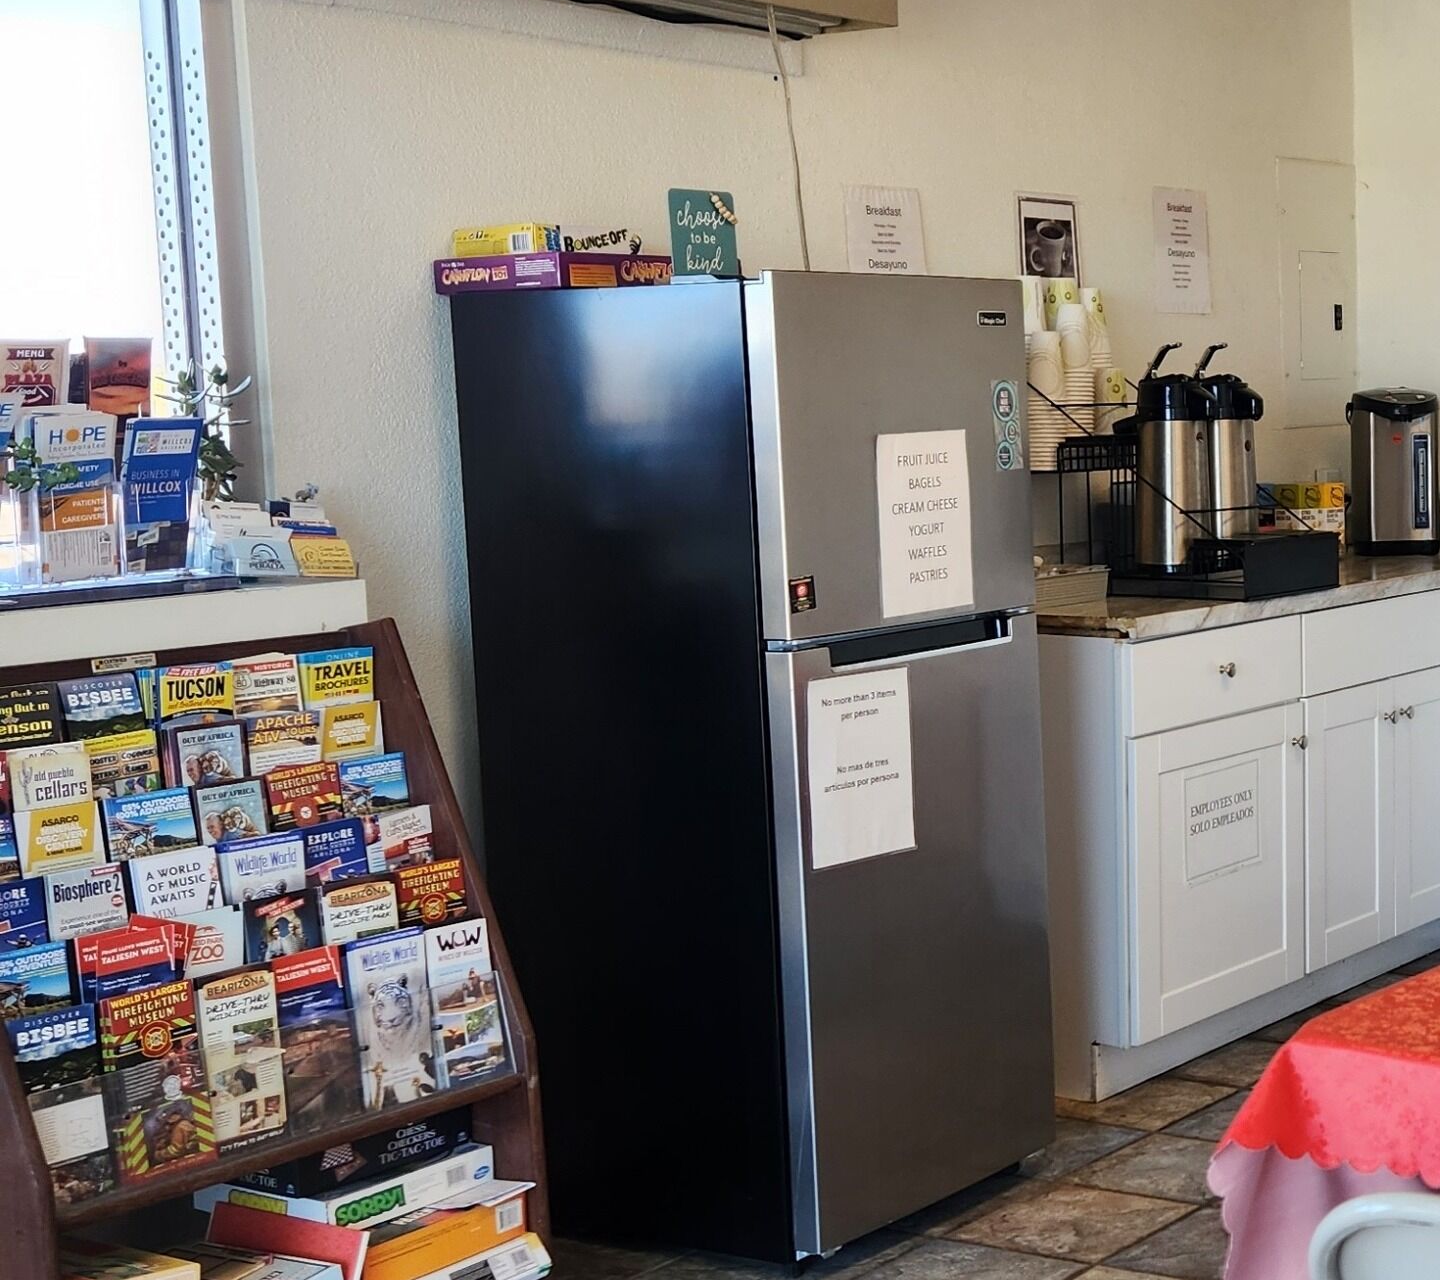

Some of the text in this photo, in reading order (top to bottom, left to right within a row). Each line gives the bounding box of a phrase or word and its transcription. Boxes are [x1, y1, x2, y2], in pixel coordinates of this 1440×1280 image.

[866, 204, 902, 217] Breakfast
[1167, 202, 1193, 213] Breakfast
[564, 228, 629, 253] BOUNCE-OFF
[691, 231, 716, 245] to be
[686, 247, 724, 273] kind
[868, 258, 908, 271] Desayuno
[50, 426, 106, 445] HOPE
[50, 442, 106, 453] incorporated
[897, 451, 949, 468] FRUIT JUICE
[131, 468, 180, 480] BUSINESS IN
[130, 480, 182, 495] WILLCOX
[908, 476, 942, 490] BAGELS
[892, 497, 959, 515] CREAM CHEESE
[909, 522, 945, 537] YOGURT
[908, 545, 948, 561] WAFFLES
[249, 561, 286, 570] PERALTA
[909, 568, 948, 584] PASTRIES
[254, 661, 292, 671] HISTORIC
[314, 661, 371, 681] TRAVEL
[72, 680, 123, 692] DISCOVER
[167, 675, 226, 702] TUCSON
[314, 676, 370, 691] BROCHURES
[67, 687, 134, 708] BISBEE
[822, 688, 897, 708] No more than 3 items
[14, 702, 36, 713] Out
[841, 707, 879, 722] per person
[0, 719, 53, 736] enson
[255, 712, 313, 731] APACHE
[182, 737, 197, 745] OUT
[207, 731, 234, 742] AFRICA
[253, 730, 281, 746] ATV
[34, 767, 74, 783] old pueblo
[837, 758, 889, 775] No mas de tres
[857, 777, 869, 788] por
[870, 772, 900, 786] persona
[36, 780, 88, 802] cellars
[202, 786, 256, 802] OUT OF AFRICA
[1190, 789, 1253, 818] EMPLOYEES ONLY
[41, 815, 80, 828] ASARCO
[1190, 806, 1254, 836] SOLO EMPLEADOS
[307, 828, 354, 845] EXPLORE
[235, 846, 297, 874] Wildlife World
[146, 862, 201, 882] A WORLD
[402, 869, 460, 889] FIREFIGHTING
[53, 873, 121, 904] Biosphere 2
[148, 873, 207, 894] OF MUSIC
[151, 888, 196, 906] AWAITS
[330, 885, 388, 904] BEARIZONA
[15, 948, 66, 965] OUTDOORS
[102, 950, 140, 965] TALIESIN
[140, 944, 165, 956] WEST
[191, 943, 225, 962] ZOO
[13, 958, 66, 975] ADVENTURE
[206, 974, 266, 997] BEARIZONA
[110, 992, 149, 1009] WORLD'S
[151, 981, 189, 999] LARGEST
[114, 991, 189, 1021] FIREFIGHTING
[205, 992, 270, 1016] DRIVE-THRU
[249, 1002, 269, 1012] PARK
[24, 1010, 80, 1028] DISCOVER
[129, 1006, 176, 1028] MUSEUM
[16, 1017, 90, 1047] BISBEE
[395, 1122, 427, 1139] CHESS
[387, 1128, 436, 1152] CHECKERS
[378, 1135, 446, 1165] TIC-TAC-TOE
[335, 1183, 406, 1227] SORRY!
